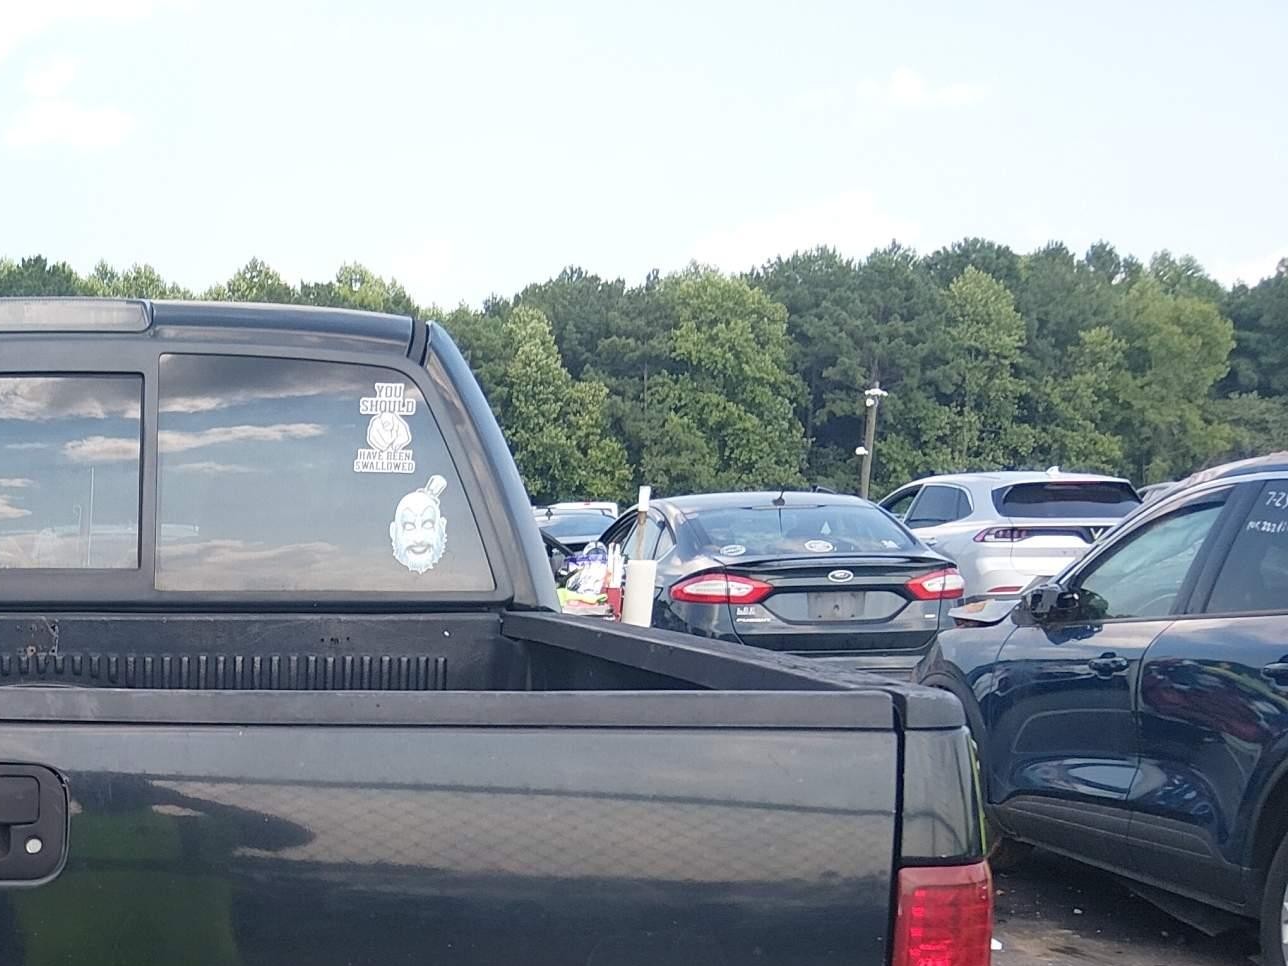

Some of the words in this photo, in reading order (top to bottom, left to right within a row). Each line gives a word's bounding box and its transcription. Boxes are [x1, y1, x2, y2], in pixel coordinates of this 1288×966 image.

[375, 384, 404, 399] YOU
[360, 399, 416, 414] SHOULD
[357, 450, 385, 461] HAVE
[386, 450, 411, 461] BEEN
[355, 460, 415, 472] SWALLOWED
